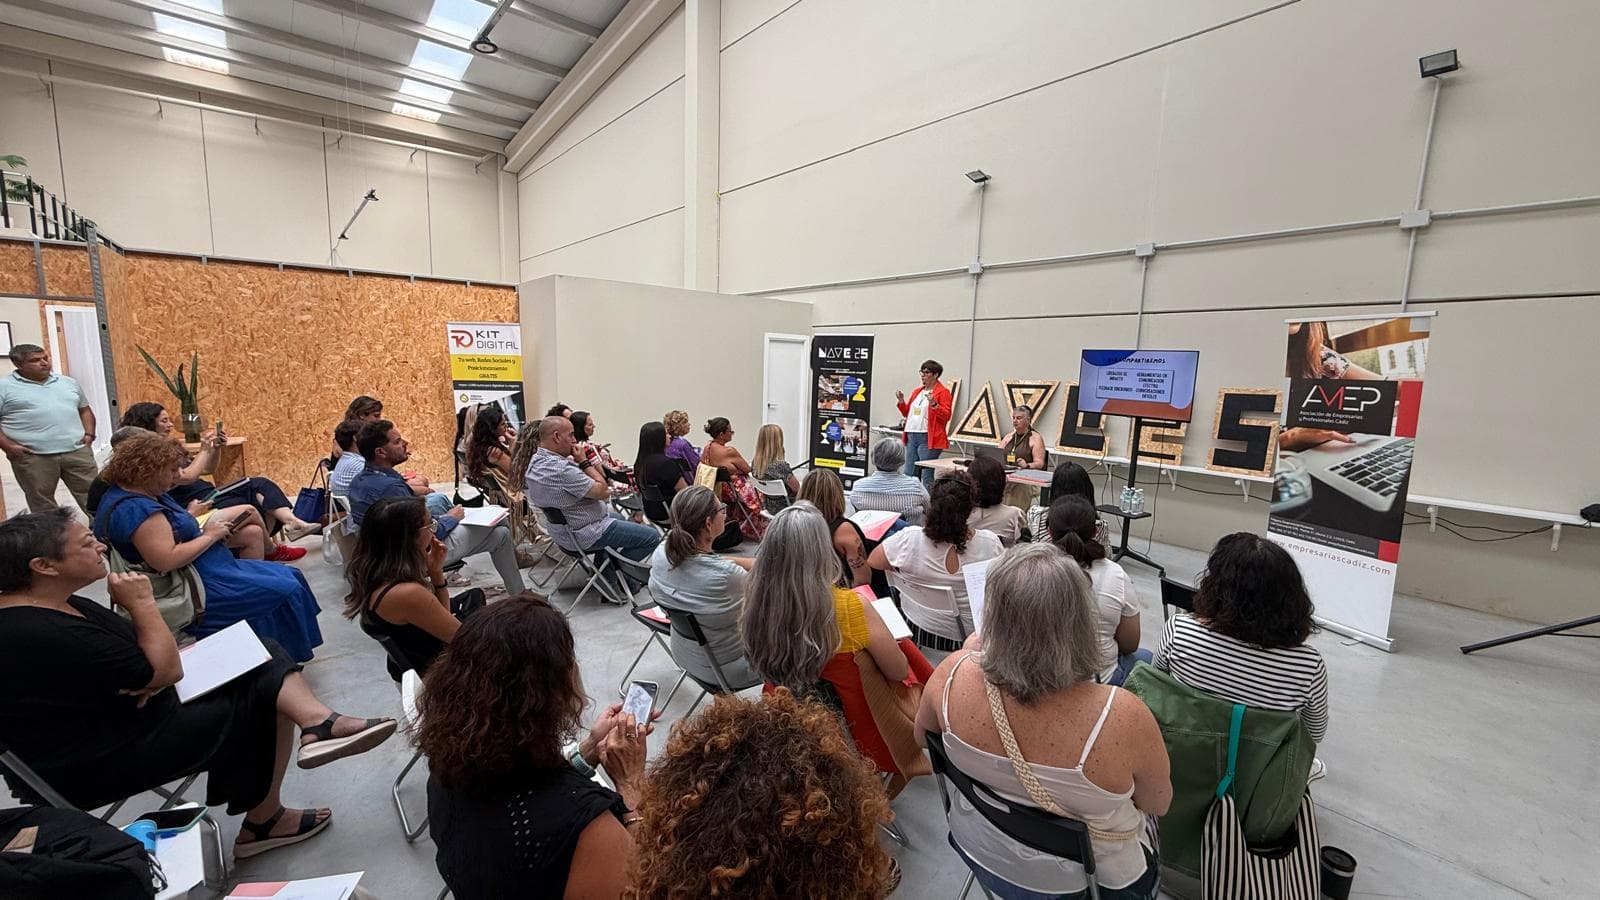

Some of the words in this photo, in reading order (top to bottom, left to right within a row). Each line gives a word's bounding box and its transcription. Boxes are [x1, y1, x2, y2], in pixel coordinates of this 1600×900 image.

[476, 330, 500, 339] KIT
[476, 340, 518, 350] DIGITAL
[818, 347, 851, 358] NAVE
[854, 348, 868, 359] 25
[1301, 385, 1382, 412] AMEP
[1273, 540, 1391, 576] ww.empresariascadiz.com
